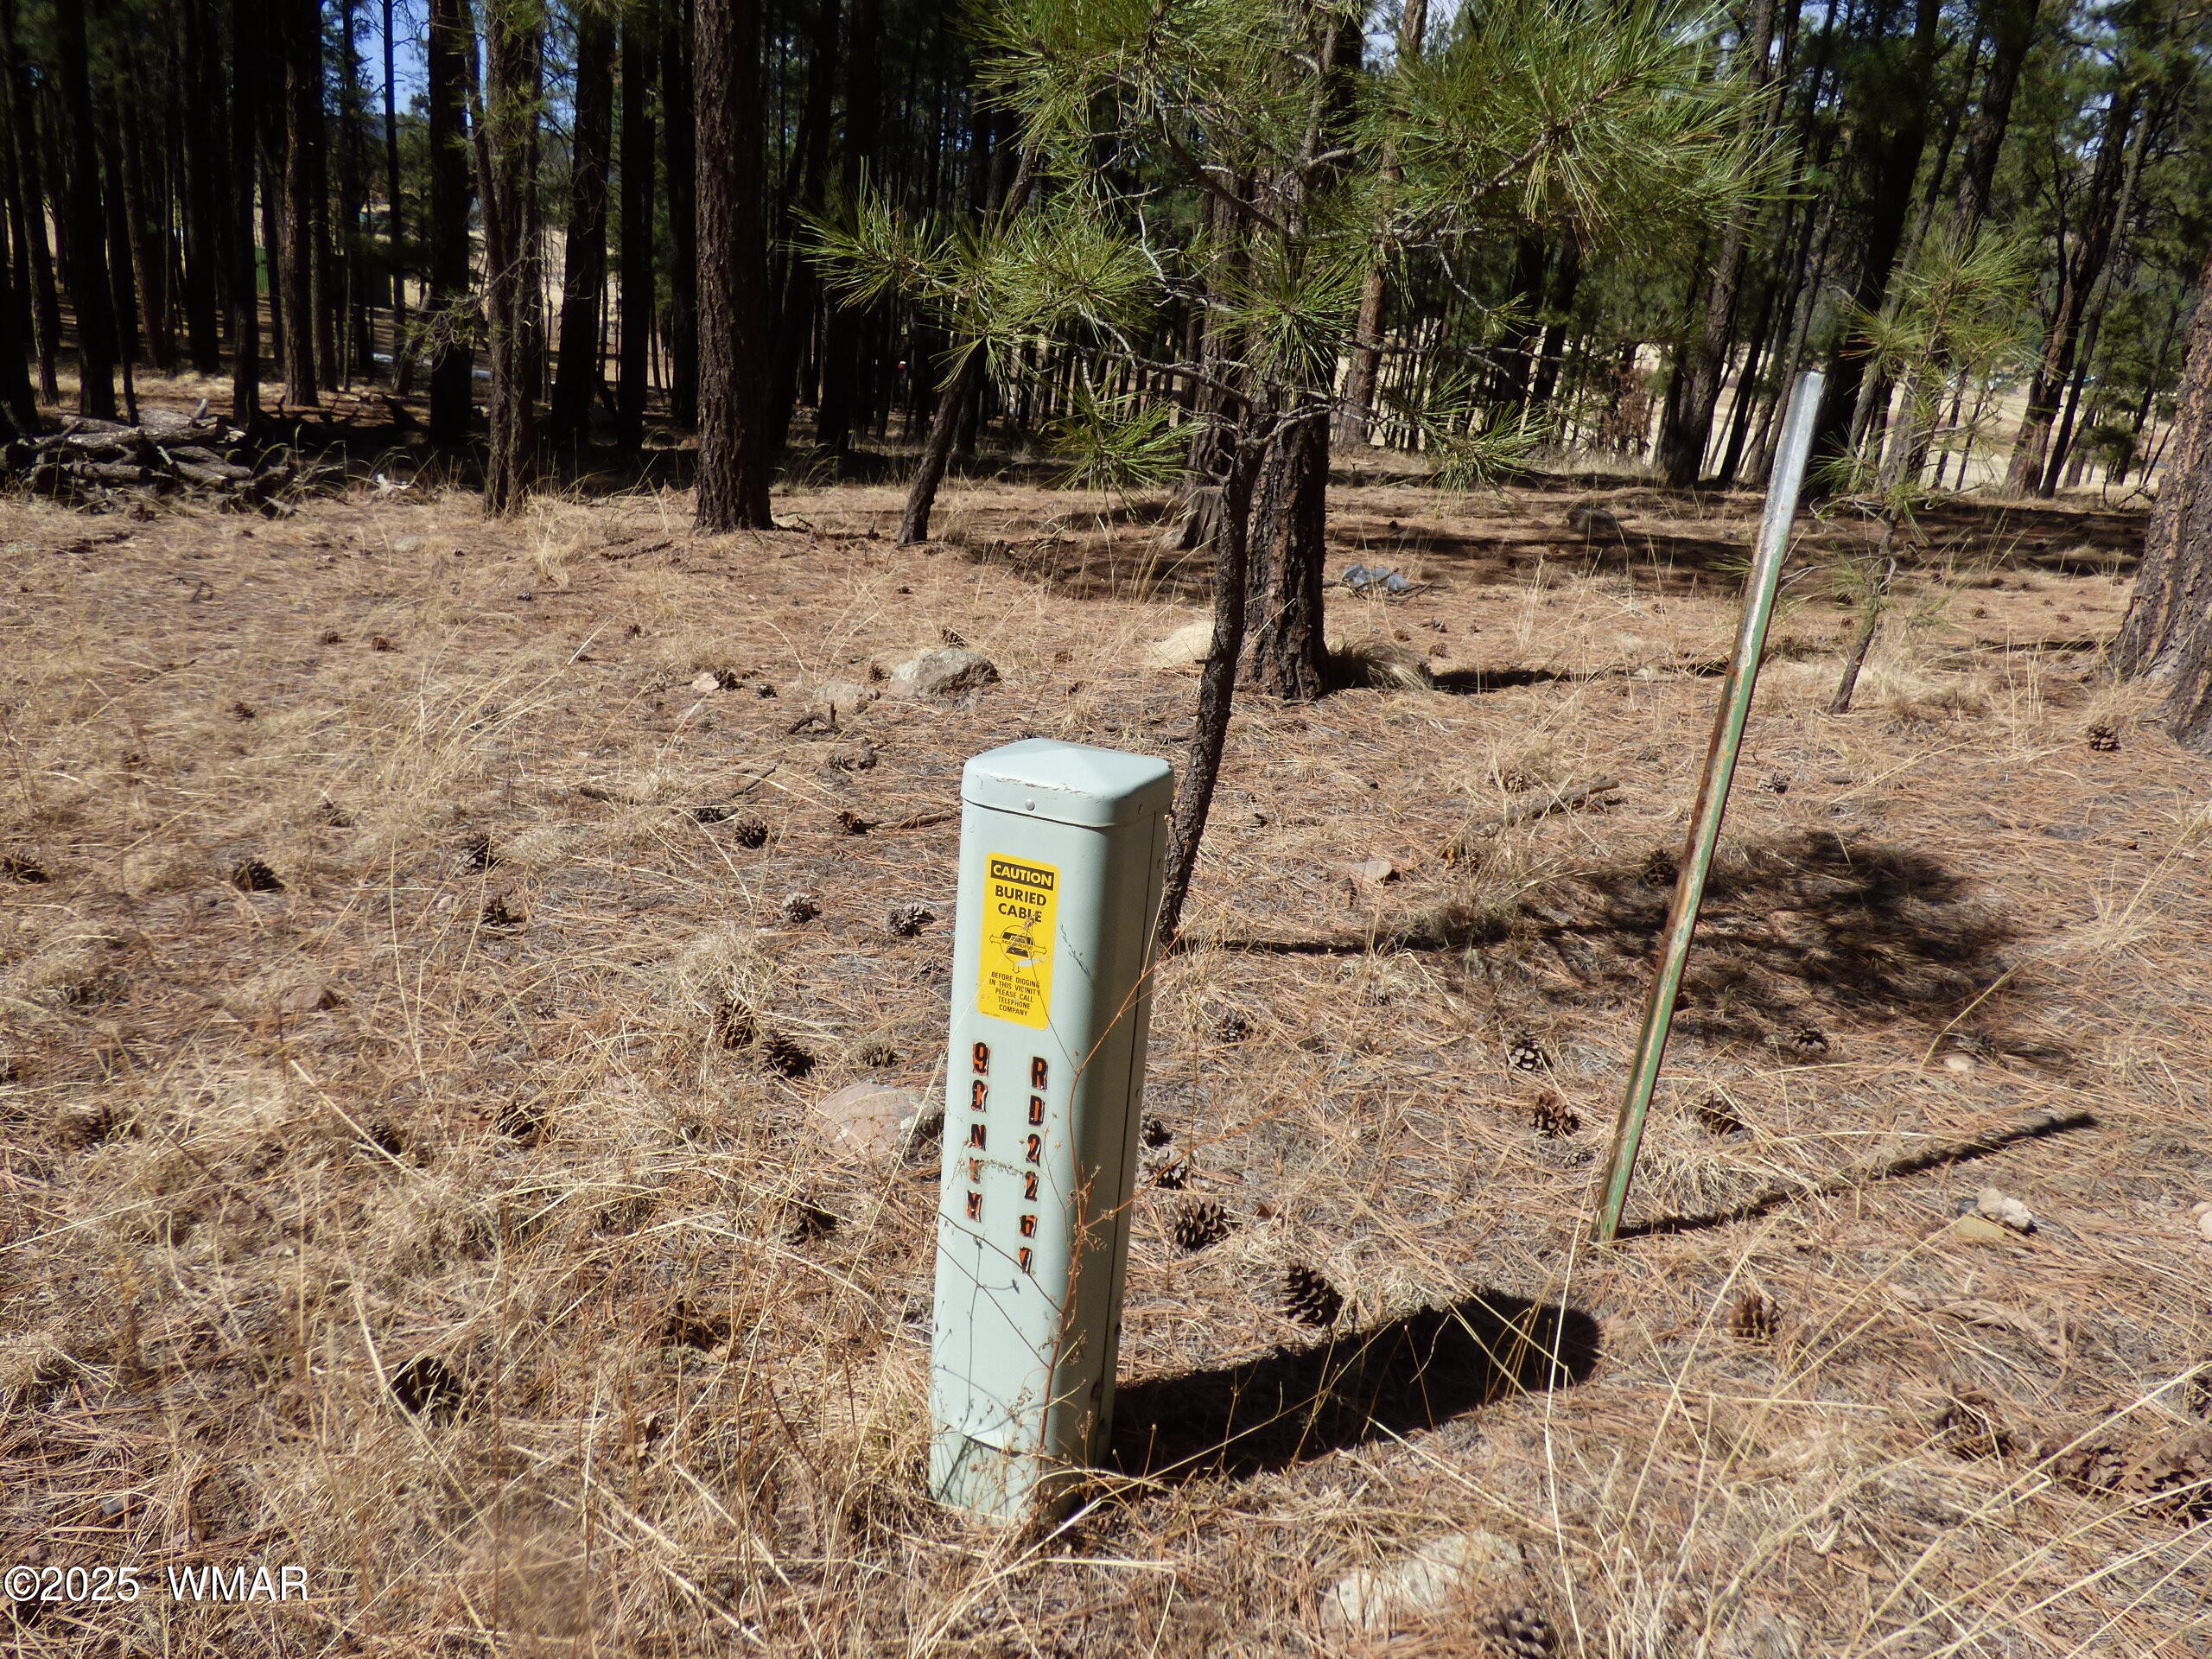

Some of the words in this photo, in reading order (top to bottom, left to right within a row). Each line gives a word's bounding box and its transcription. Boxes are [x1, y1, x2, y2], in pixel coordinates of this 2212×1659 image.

[993, 864, 1052, 887] CAUTION
[995, 884, 1047, 906] BURIED
[998, 902, 1043, 923] CABLE
[991, 970, 1014, 982] BEFORE
[1015, 976, 1040, 989] DIGGING
[999, 980, 1013, 989] THIS
[1014, 984, 1040, 996] VICINITY
[995, 987, 1017, 999] PLEASE
[1019, 993, 1034, 1003] CALL
[998, 995, 1031, 1009] TELEPHONE
[999, 1004, 1028, 1016] COMPANY
